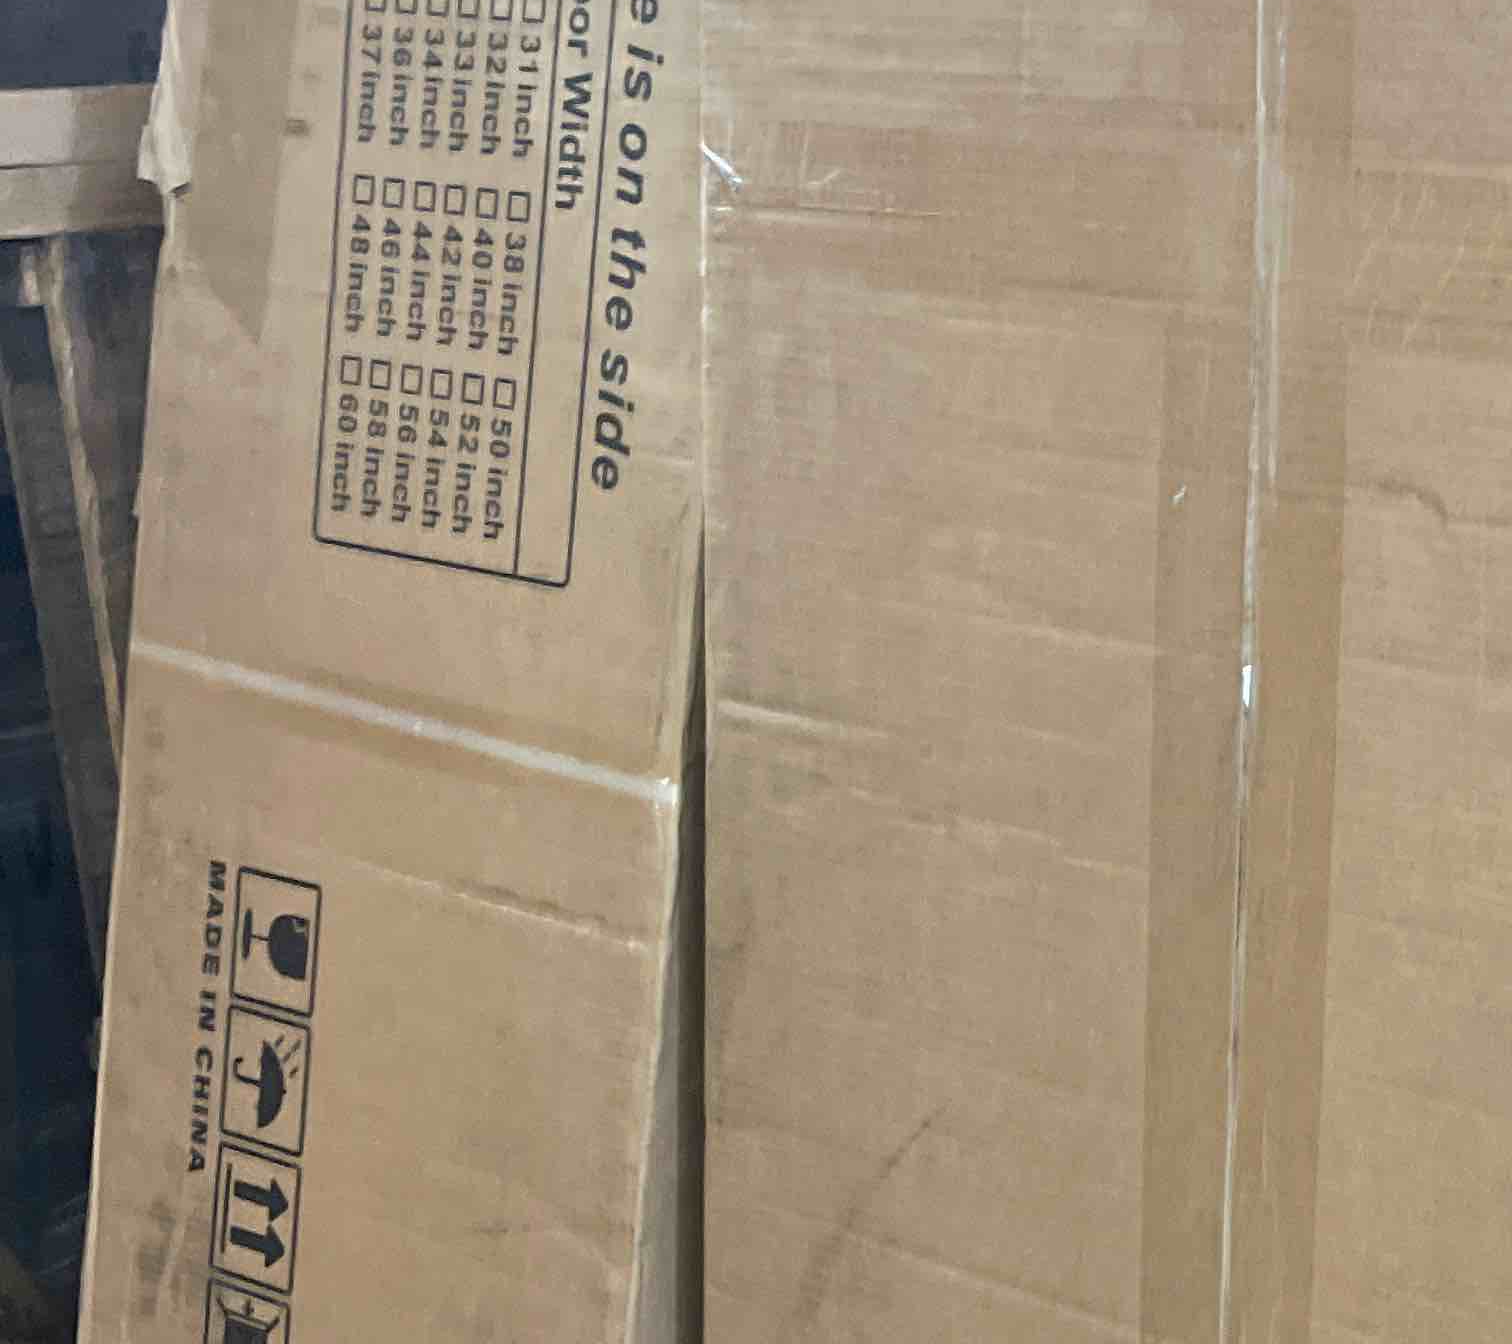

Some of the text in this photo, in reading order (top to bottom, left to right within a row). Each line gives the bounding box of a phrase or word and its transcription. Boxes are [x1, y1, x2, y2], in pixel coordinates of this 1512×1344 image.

[362, 23, 383, 64] 37
[393, 26, 414, 66] 36
[424, 27, 444, 69] 34
[455, 31, 478, 71] 33
[488, 31, 509, 74] 32
[519, 34, 542, 74] 31
[625, 43, 663, 102] is
[554, 72, 593, 211] Width
[617, 123, 648, 207] on
[350, 213, 371, 255] 48
[381, 217, 401, 259] 46
[411, 220, 432, 262] 44
[441, 224, 463, 265] 42
[472, 227, 495, 269] 40
[504, 231, 527, 273] 38
[605, 230, 647, 331] the
[338, 393, 359, 433] 60
[368, 399, 389, 438] 58
[398, 403, 419, 443] 56
[429, 408, 449, 448] 54
[458, 413, 480, 454] 52
[591, 348, 635, 492] side
[489, 418, 512, 458] 50
[188, 860, 227, 1172] MADE IN CHINA
